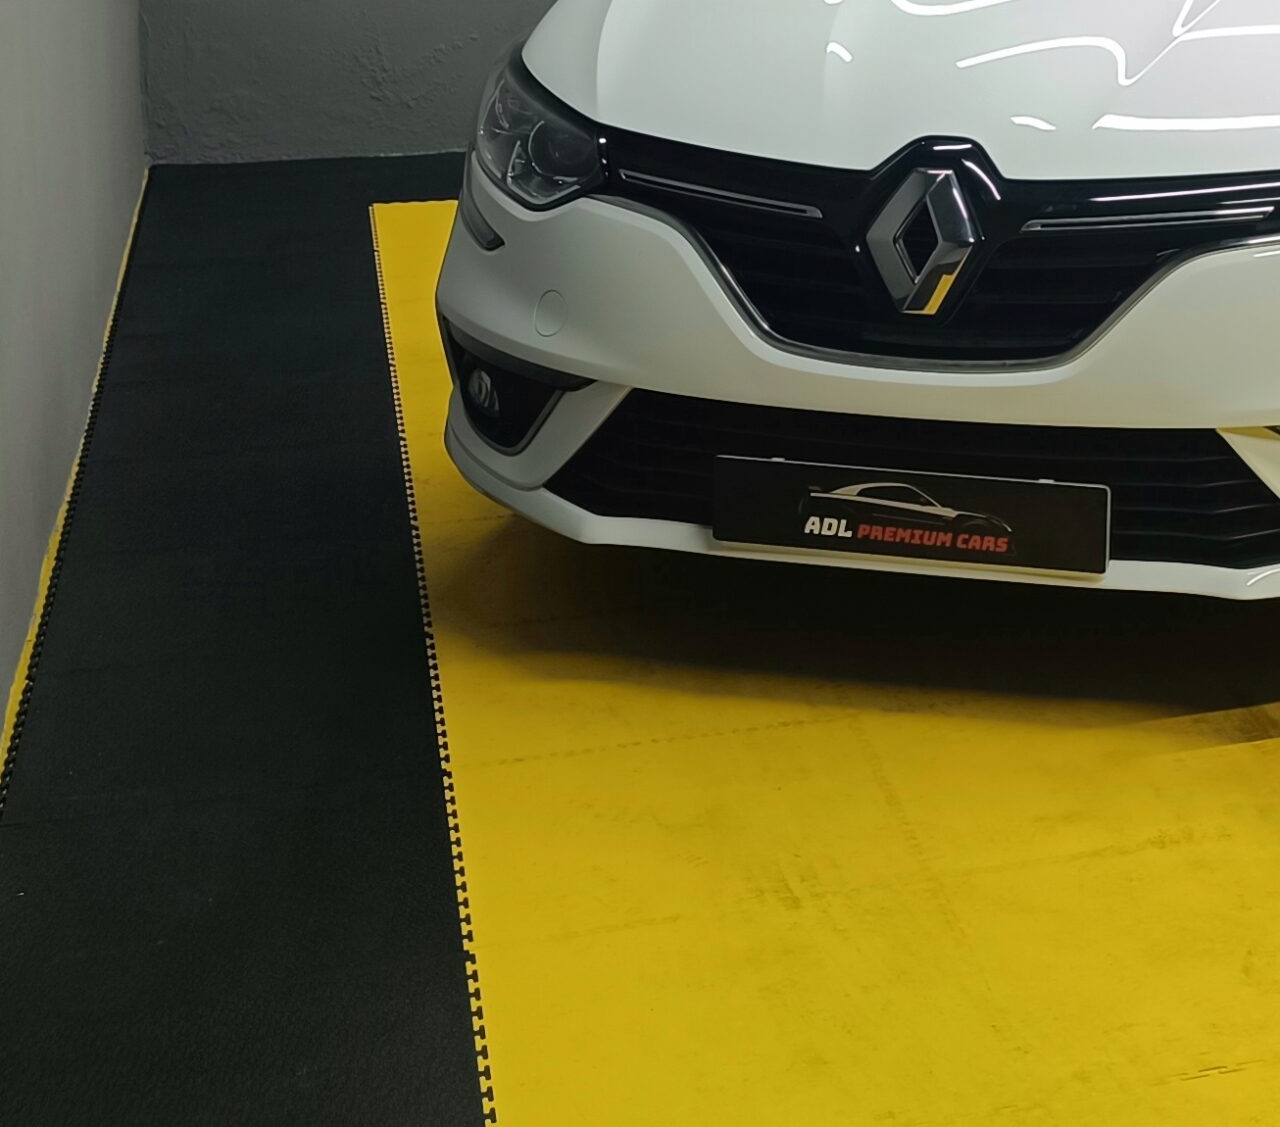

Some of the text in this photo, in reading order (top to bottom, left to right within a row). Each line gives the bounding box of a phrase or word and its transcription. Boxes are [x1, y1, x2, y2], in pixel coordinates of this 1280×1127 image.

[805, 516, 1008, 552] ADL PREMIUM CARS
